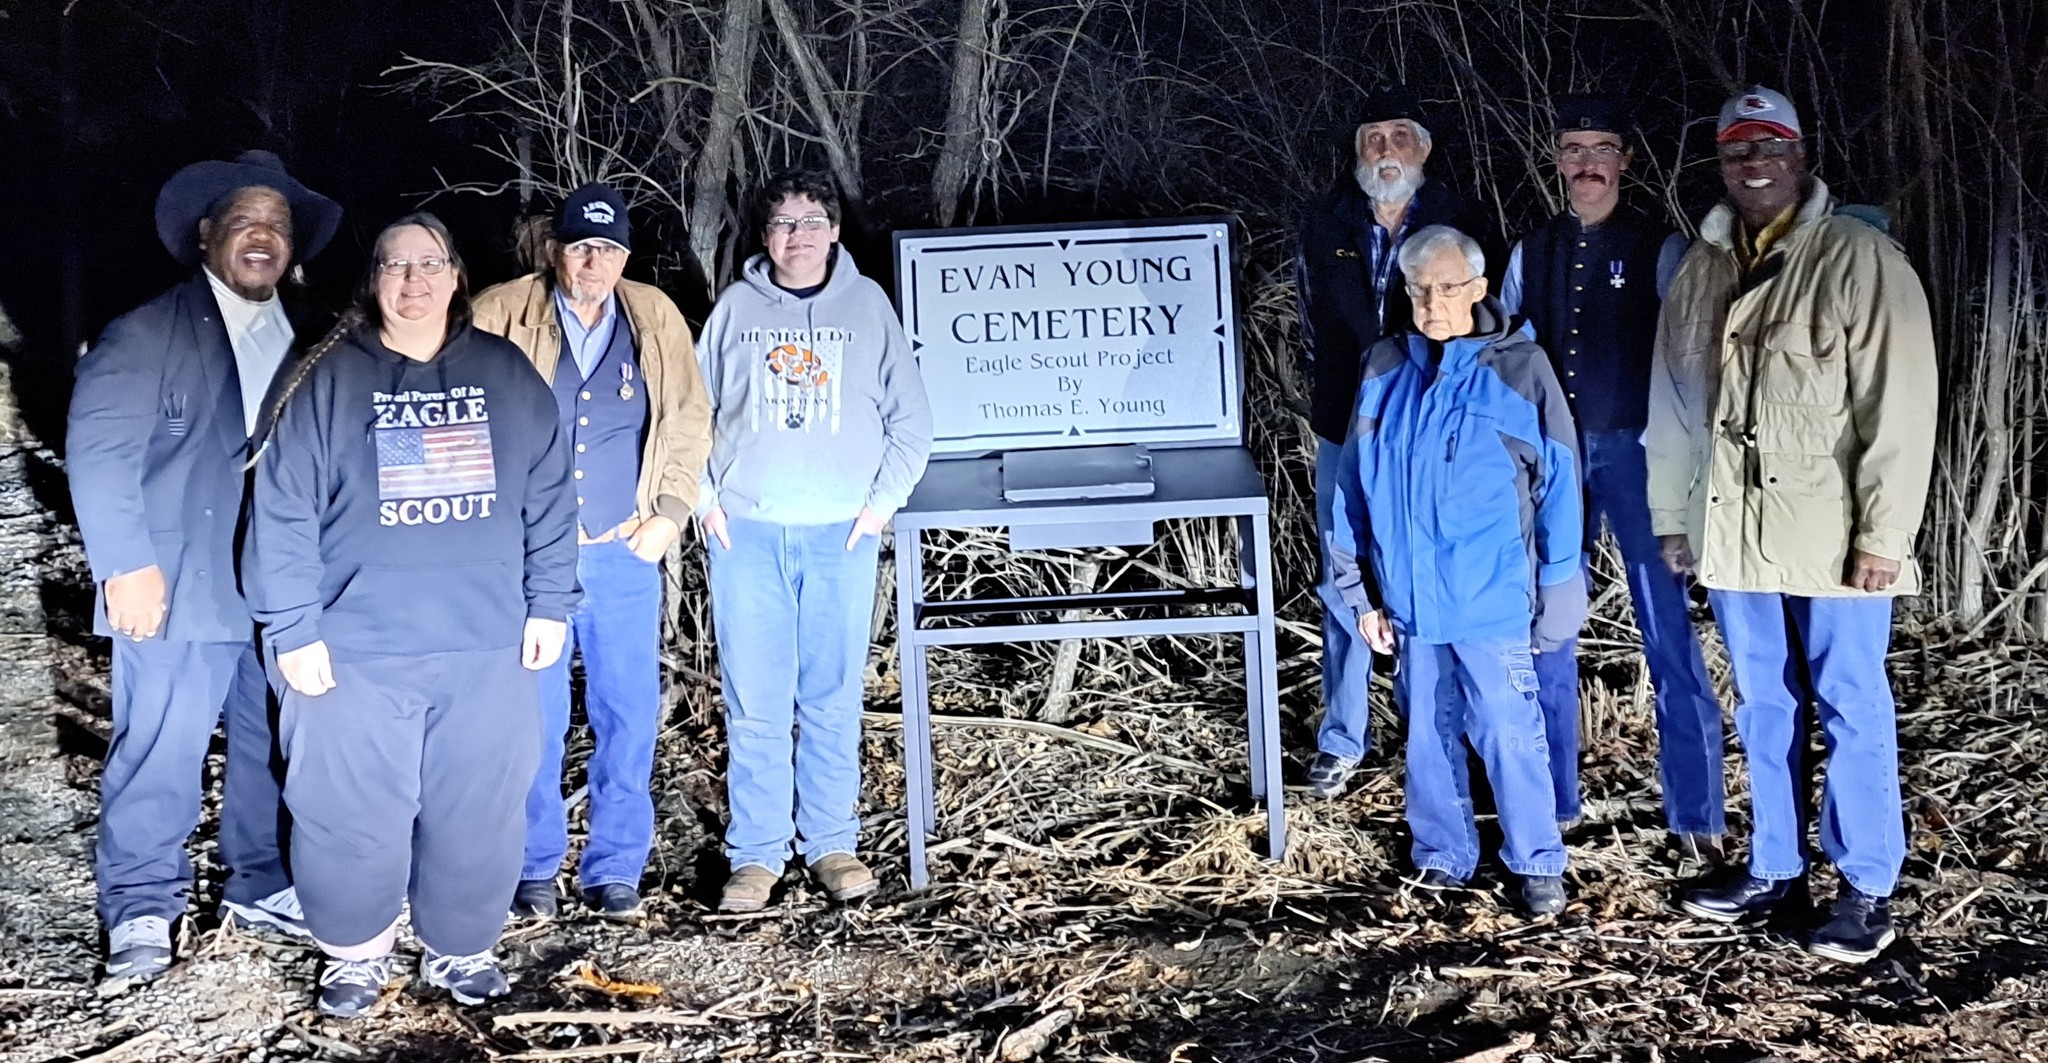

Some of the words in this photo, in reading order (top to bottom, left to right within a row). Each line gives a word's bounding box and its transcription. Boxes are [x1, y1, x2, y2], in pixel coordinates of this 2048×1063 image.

[940, 263, 1036, 294] EVAN
[1062, 256, 1192, 286] YOUNG
[951, 304, 1184, 344] CEMETERY
[965, 354, 1022, 375] Eagle
[1030, 350, 1089, 369] Scout
[1098, 347, 1175, 370] Project
[410, 390, 451, 402] Paren
[450, 387, 467, 399] Of
[468, 386, 485, 397] An
[1058, 375, 1083, 395] By
[373, 397, 489, 429] EAGLE
[978, 400, 1063, 420] Thomas
[1071, 399, 1089, 416] E.
[1098, 397, 1166, 417] Young
[379, 492, 497, 527] SCOUT
